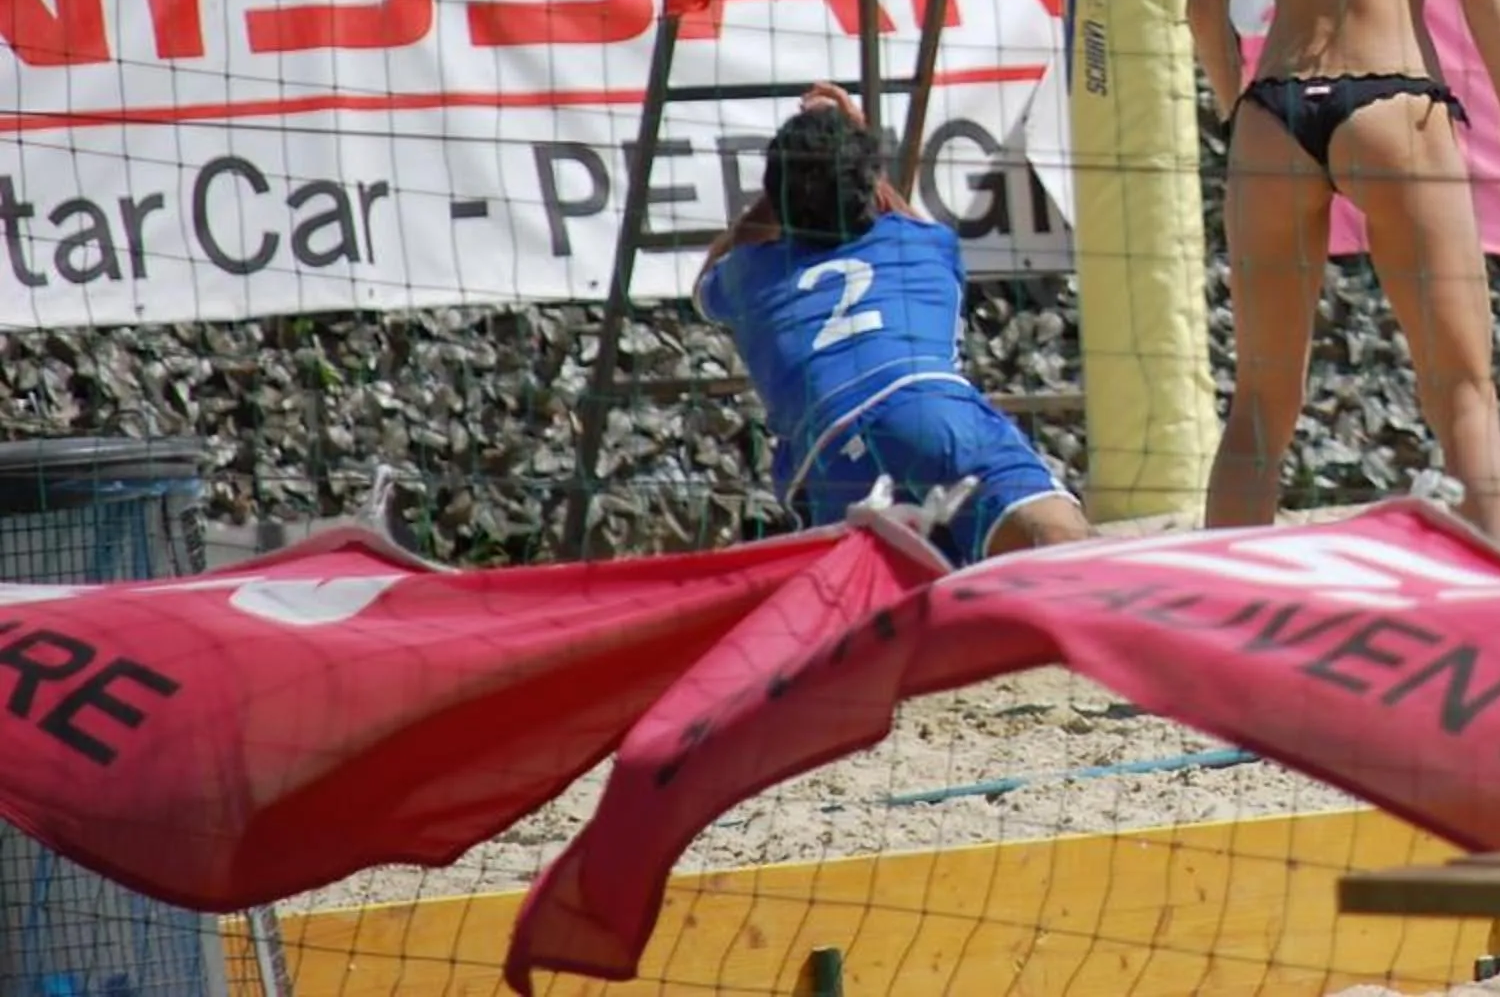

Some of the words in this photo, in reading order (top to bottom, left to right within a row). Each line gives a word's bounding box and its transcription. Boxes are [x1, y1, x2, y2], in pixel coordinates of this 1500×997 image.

[193, 155, 389, 275] Car
[797, 258, 883, 351] 2
[0, 620, 182, 767] RE
